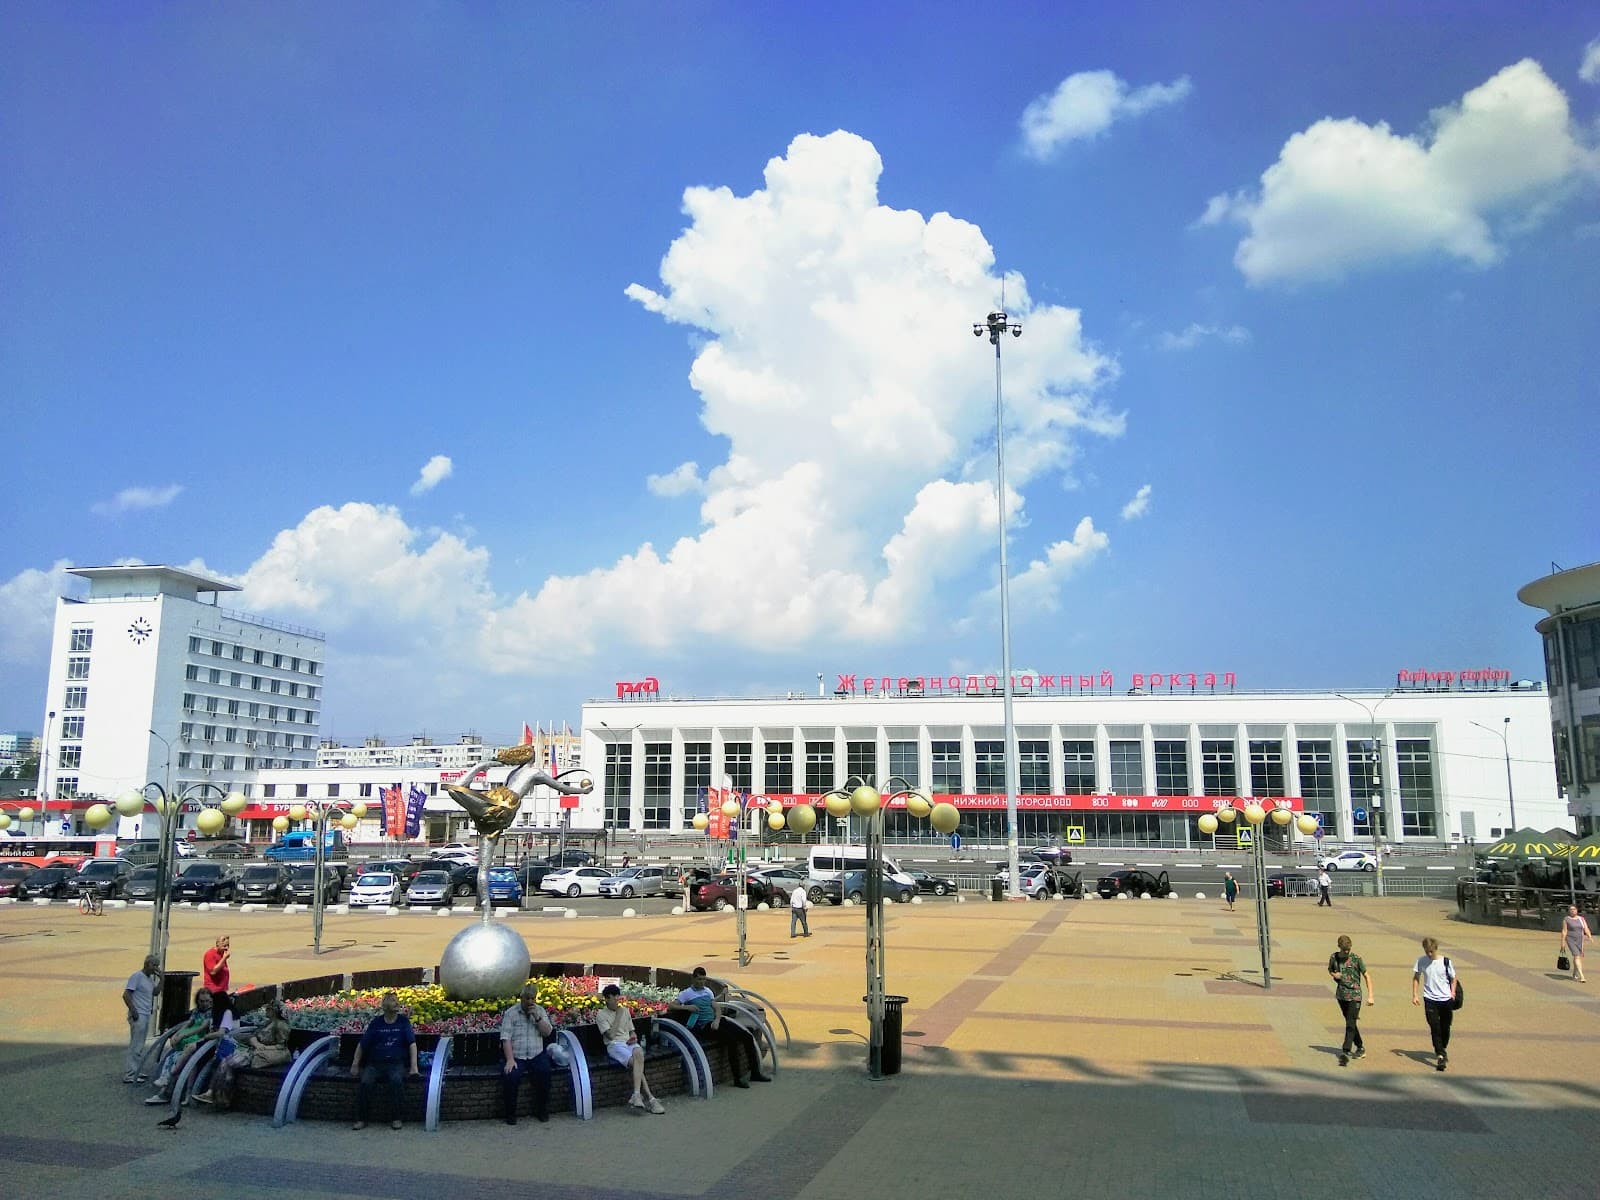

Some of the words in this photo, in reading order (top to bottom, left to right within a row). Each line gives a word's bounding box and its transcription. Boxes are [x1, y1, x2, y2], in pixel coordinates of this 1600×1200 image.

[838, 671, 1114, 693] Железнодоожный
[1132, 672, 1237, 687] вокзал
[1399, 667, 1456, 684] Railway
[1460, 667, 1512, 681] station
[953, 796, 999, 805] НИЖНИЙ
[1002, 797, 1052, 807] НВГОРОД
